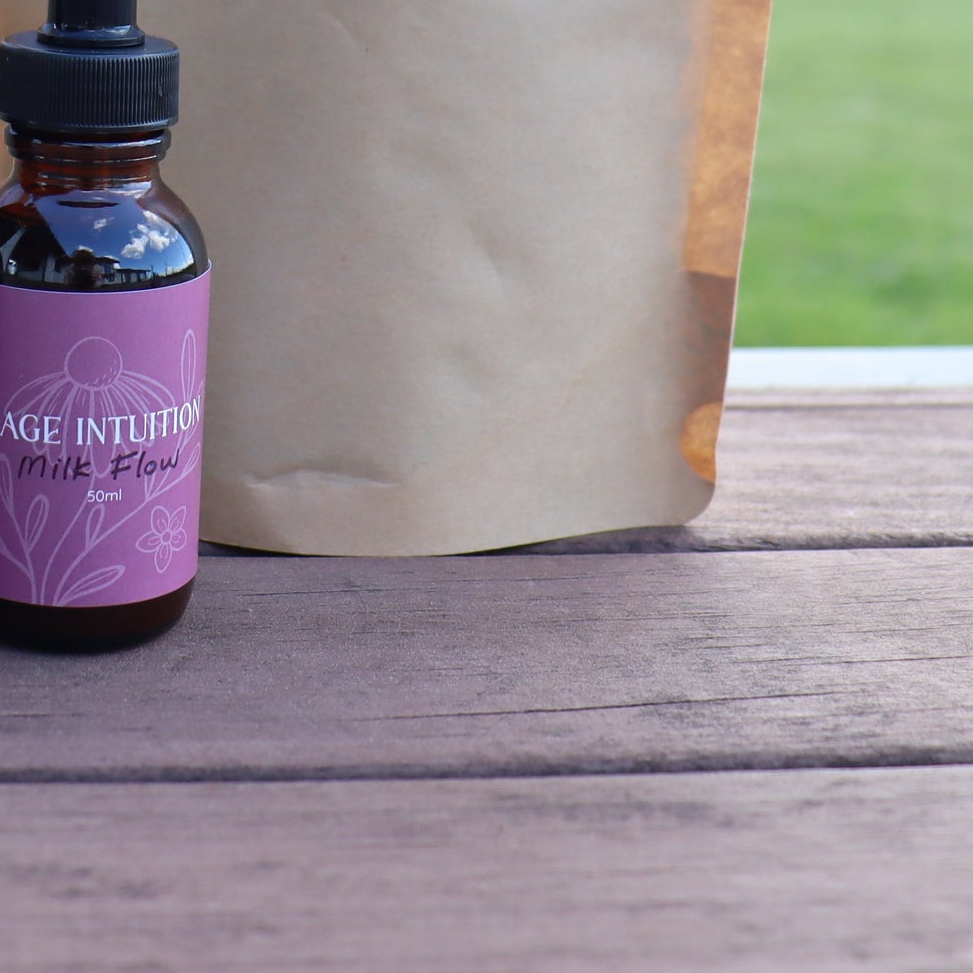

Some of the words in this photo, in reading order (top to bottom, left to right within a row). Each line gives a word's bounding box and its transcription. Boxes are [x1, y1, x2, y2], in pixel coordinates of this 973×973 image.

[76, 395, 202, 445] INTUITION
[18, 454, 91, 480] Milk
[111, 448, 180, 481] Flow
[87, 489, 123, 503] 50ml
